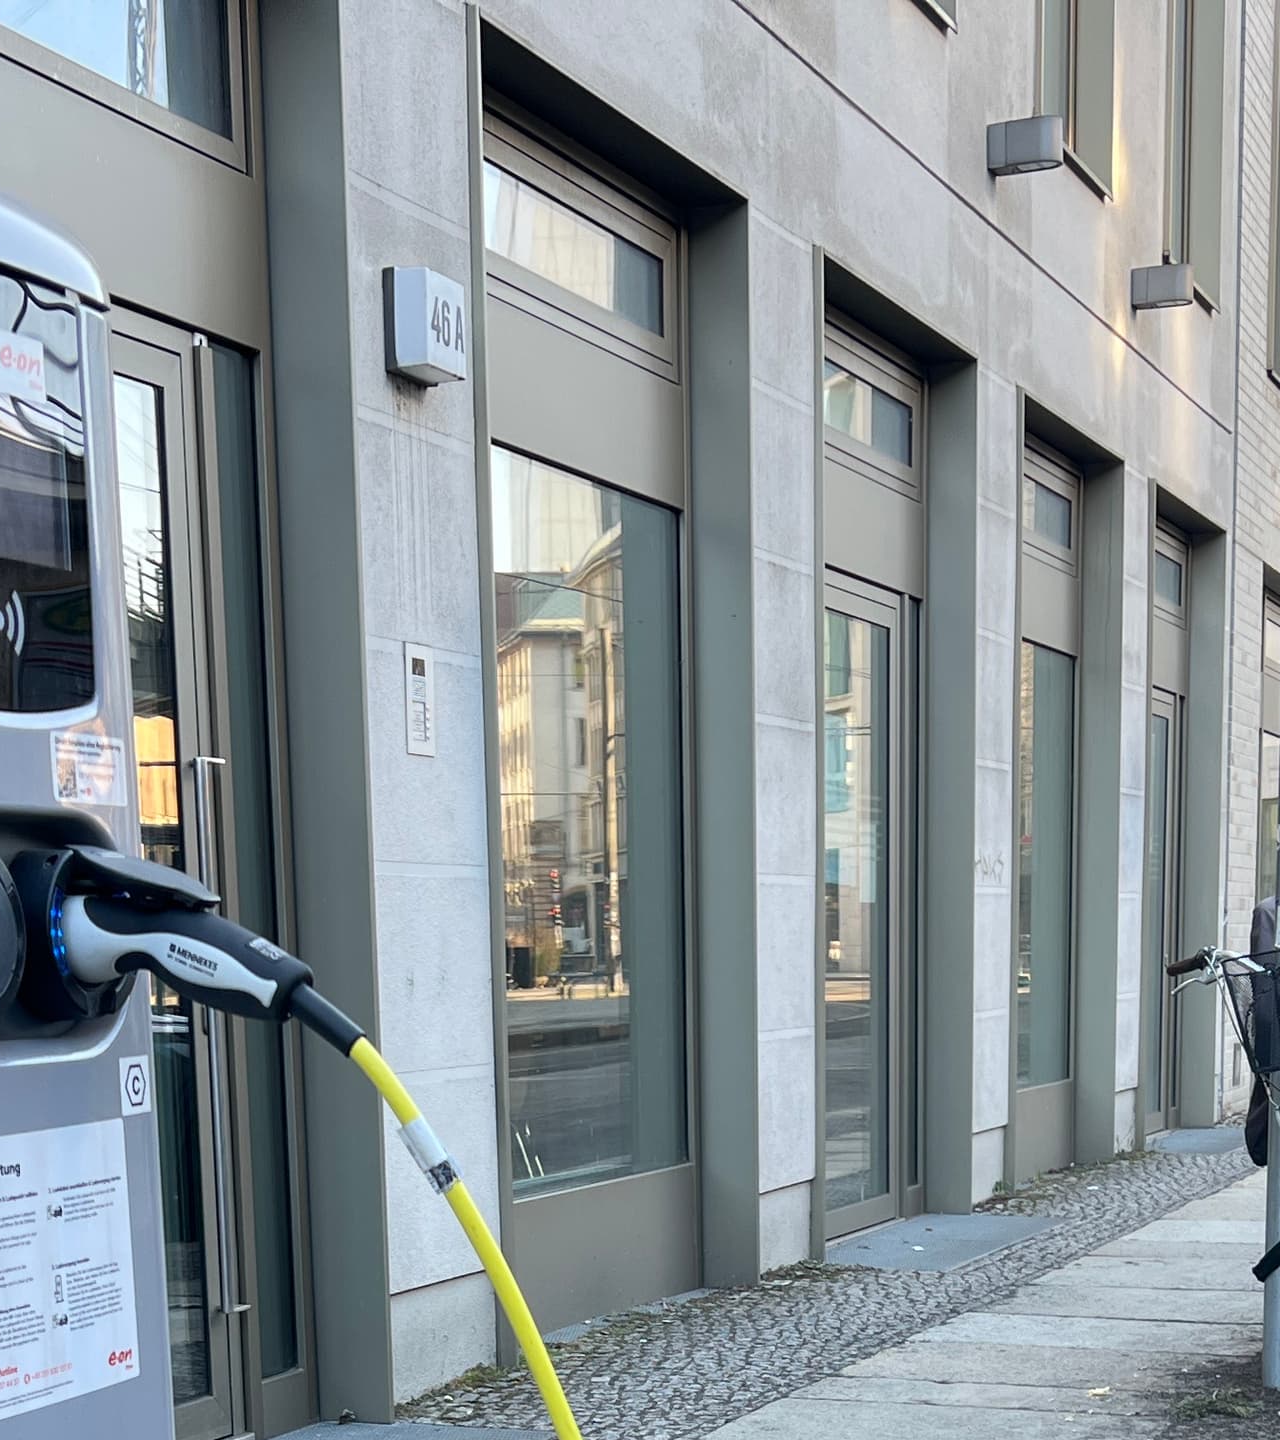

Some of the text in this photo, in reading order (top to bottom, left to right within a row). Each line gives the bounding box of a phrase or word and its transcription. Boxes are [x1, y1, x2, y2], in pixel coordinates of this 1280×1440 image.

[431, 296, 465, 354] 46 A
[132, 1075, 141, 1096] C
